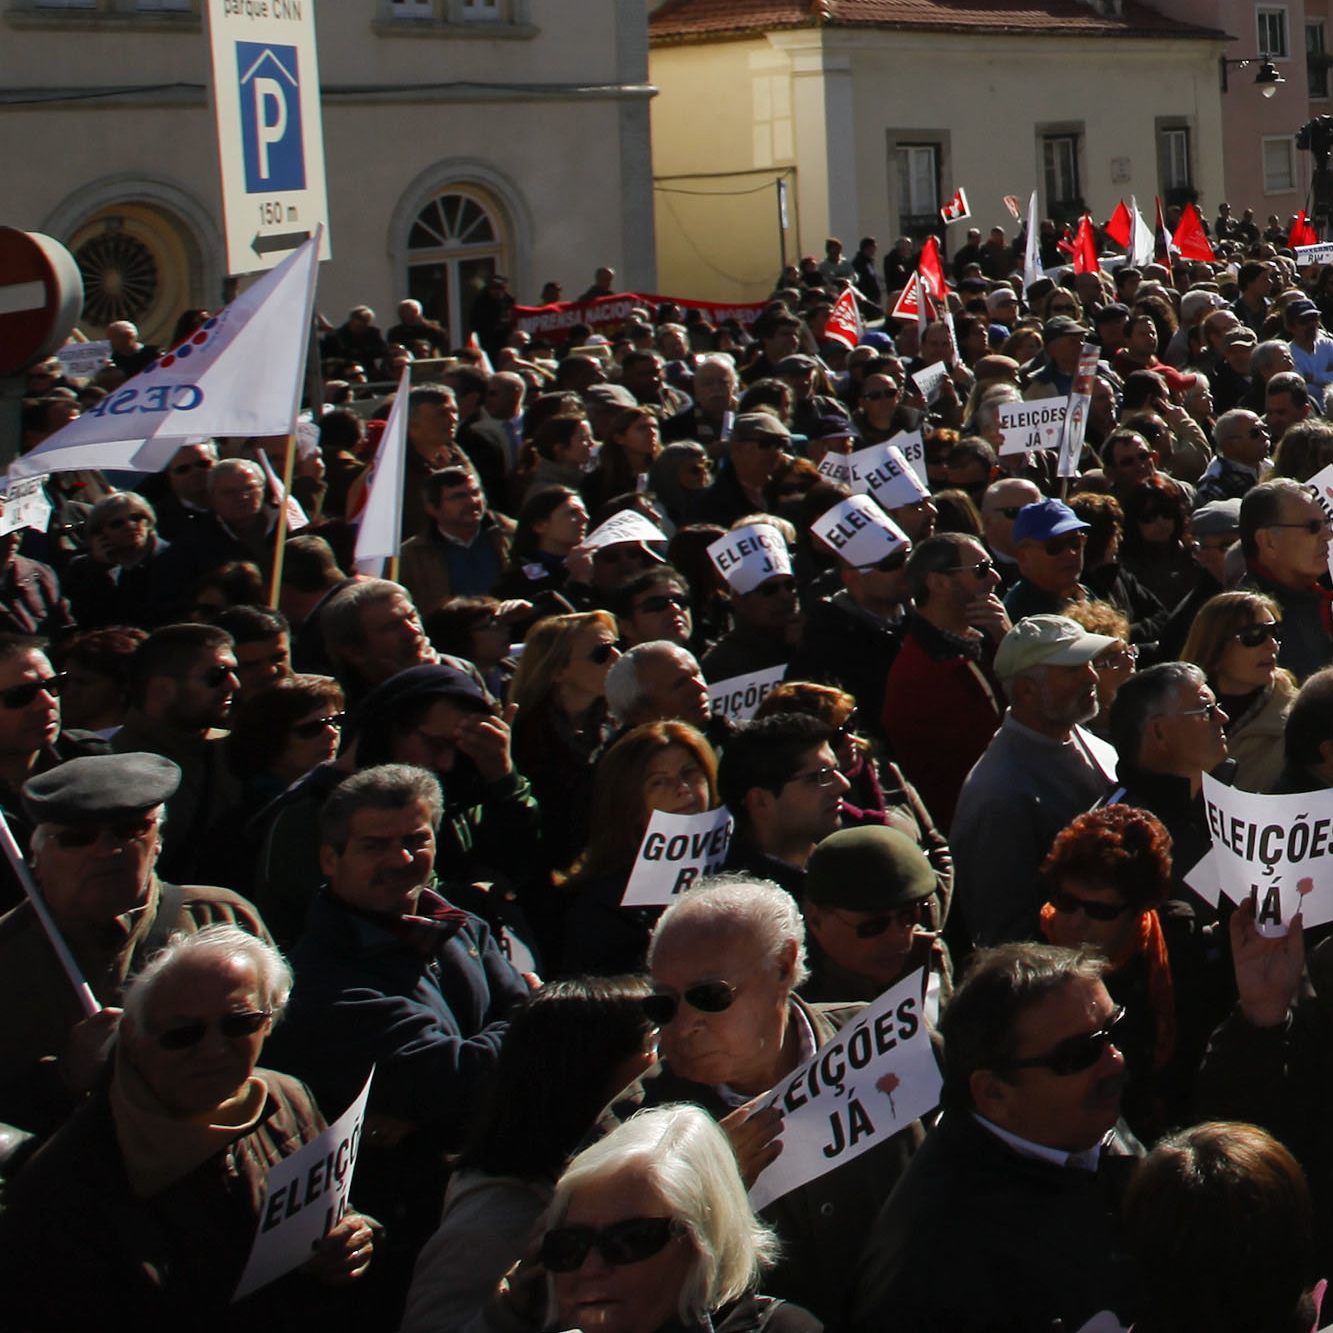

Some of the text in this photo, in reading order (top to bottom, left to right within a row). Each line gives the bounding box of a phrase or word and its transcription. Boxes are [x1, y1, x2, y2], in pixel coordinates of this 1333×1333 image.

[253, 77, 288, 180] P
[259, 202, 299, 225] 150 m
[1002, 406, 1068, 430] ELEIÇÕES
[1025, 430, 1042, 448] JÁ
[769, 997, 919, 1115] EIÇÕES
[822, 1086, 876, 1159] JÁ
